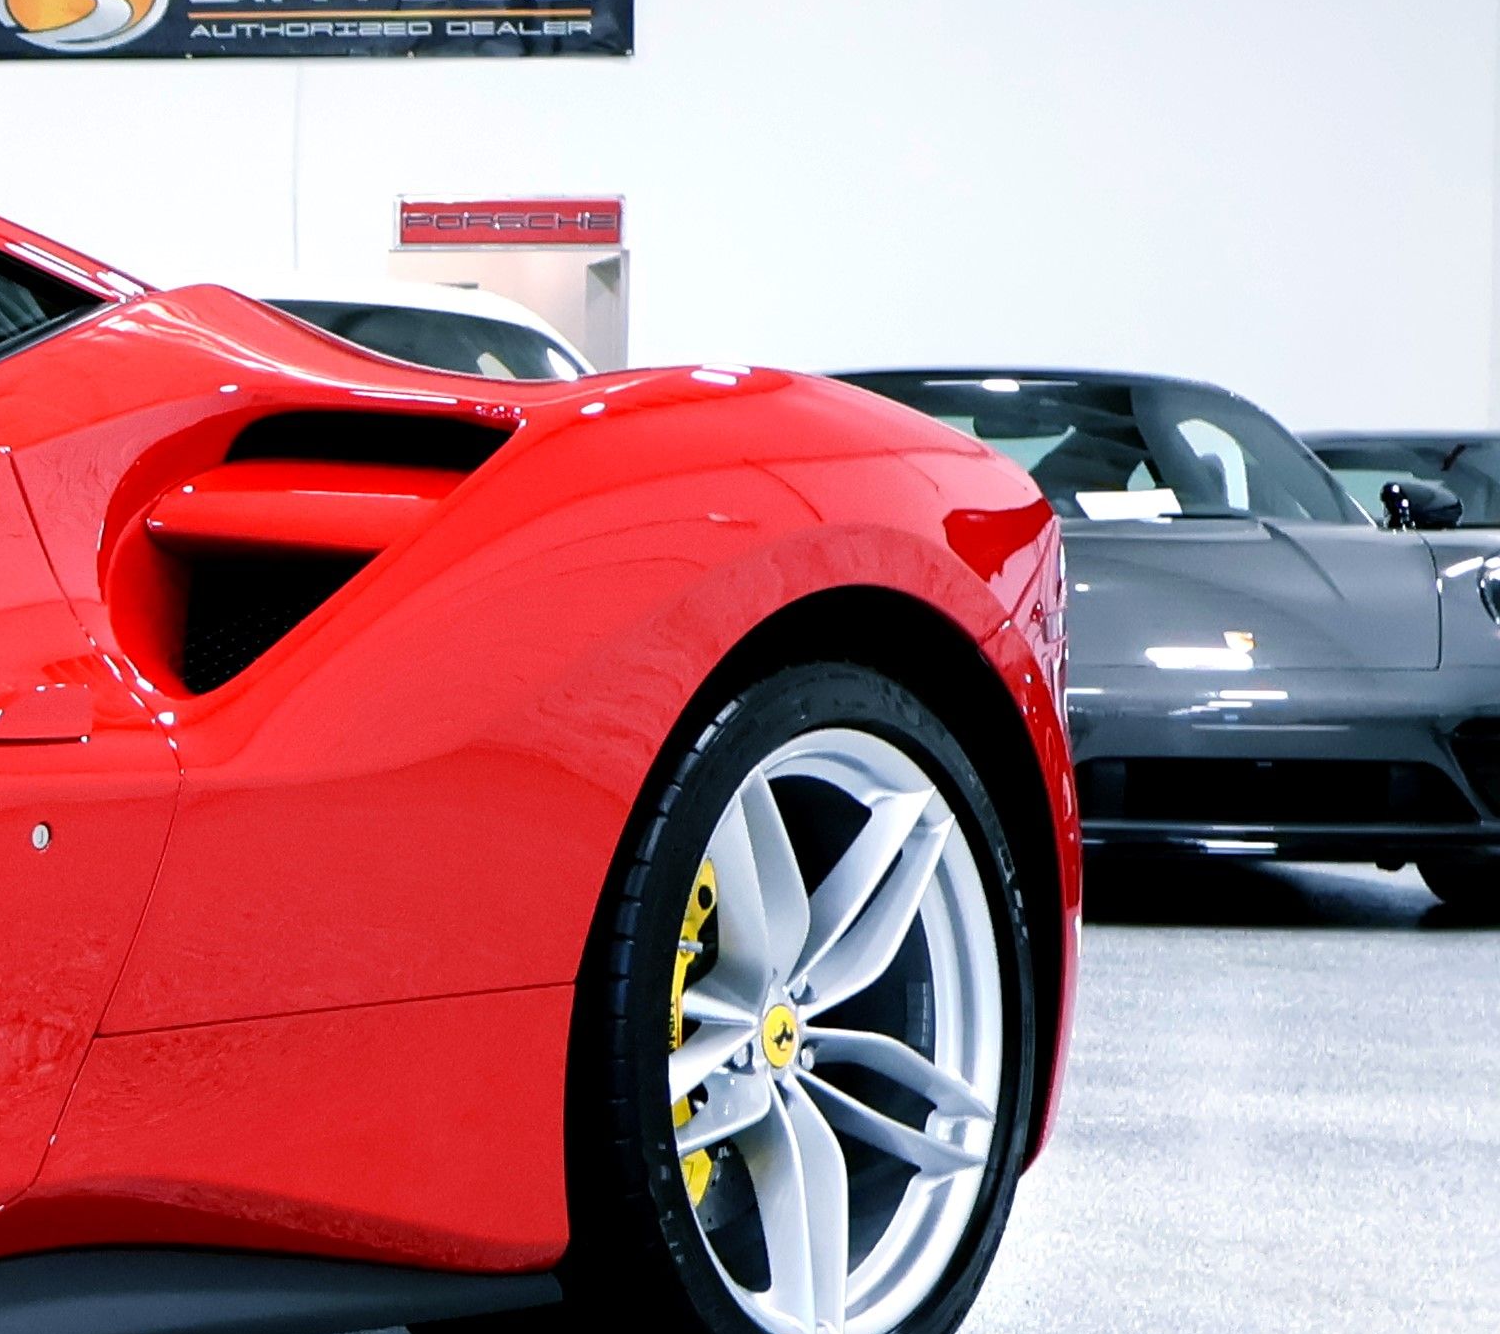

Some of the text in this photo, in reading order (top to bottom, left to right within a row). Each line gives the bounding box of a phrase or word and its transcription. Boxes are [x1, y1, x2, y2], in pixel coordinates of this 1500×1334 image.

[190, 20, 593, 38] AUTHORIZED DEALER
[402, 211, 618, 231] PORSCHE
